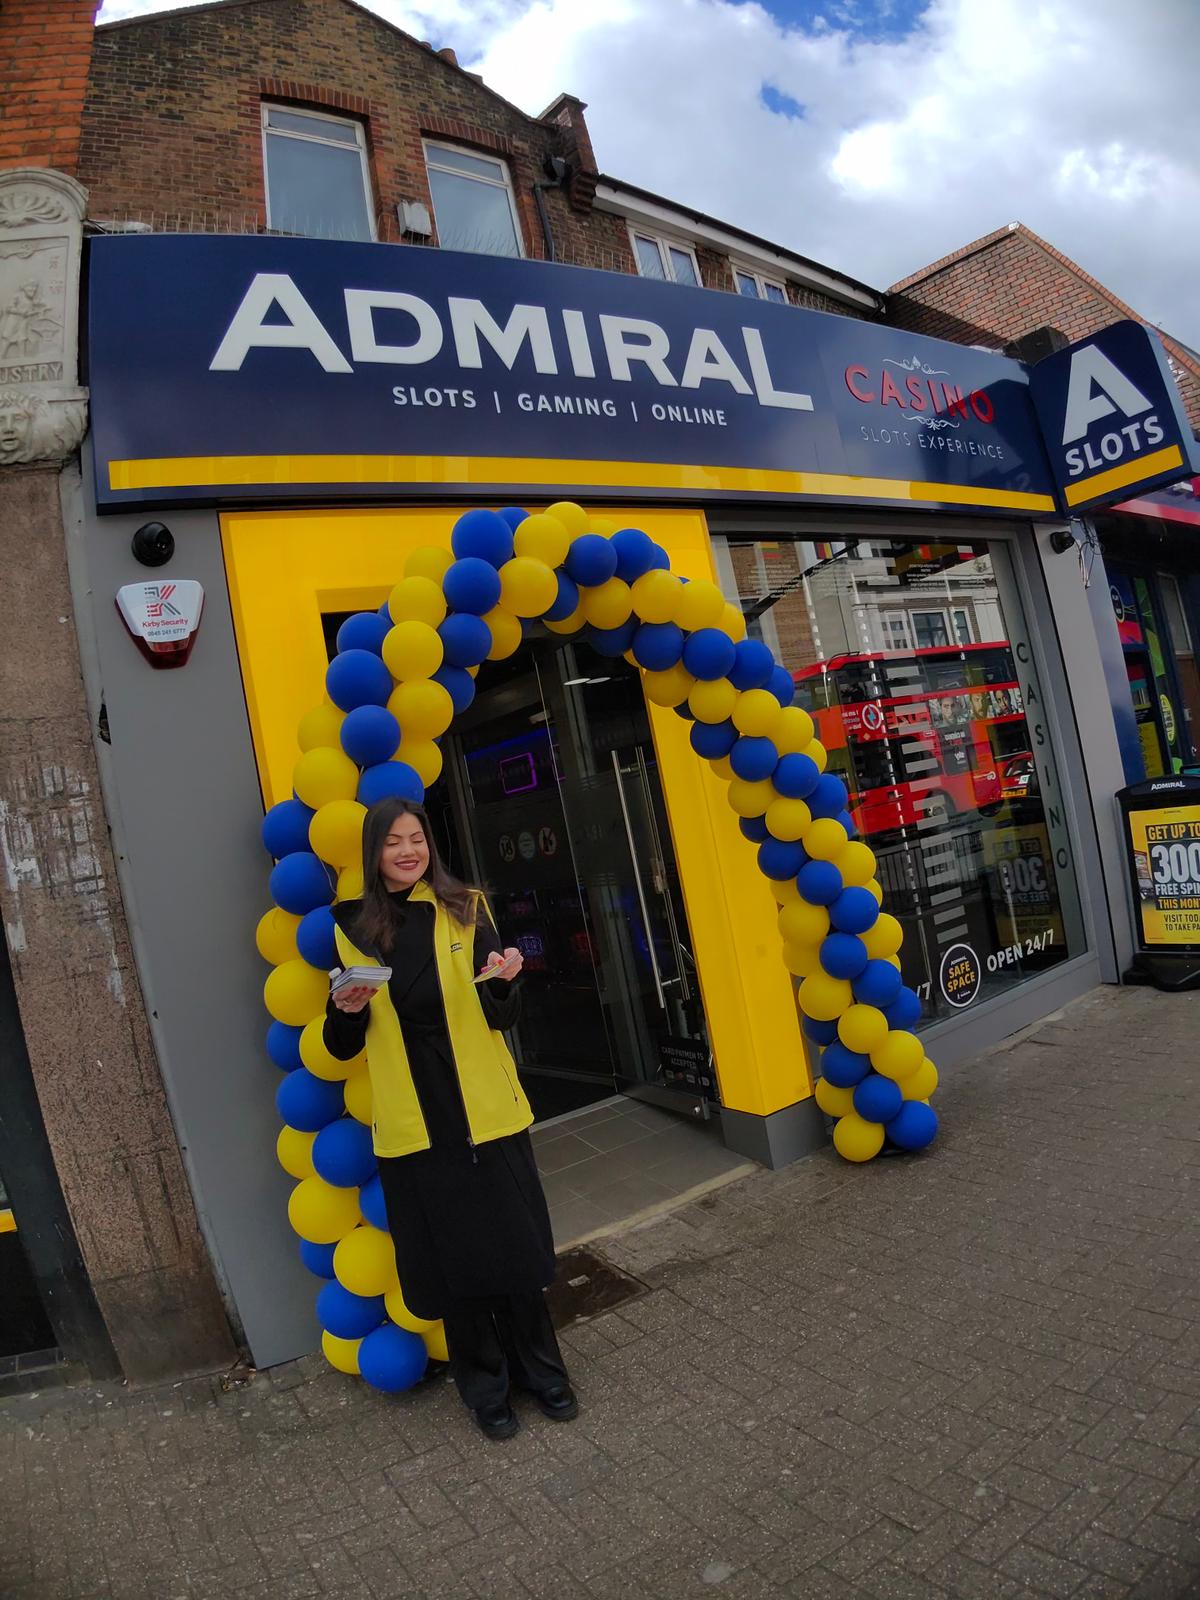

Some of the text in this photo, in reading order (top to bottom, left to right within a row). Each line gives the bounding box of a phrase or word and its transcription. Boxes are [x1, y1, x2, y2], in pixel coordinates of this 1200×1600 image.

[208, 272, 815, 412] ADMIRAL
[844, 363, 996, 424] CASINO
[1061, 343, 1154, 446] A
[392, 385, 477, 409] SLOTS
[517, 393, 618, 418] GAMING
[651, 403, 728, 427] ONLINE
[860, 425, 1005, 460] SLOTS EXPERIENCE
[1065, 415, 1165, 477] SLOTS
[160, 618, 188, 627] Security
[1150, 780, 1186, 791] ADMIRAL
[1148, 825, 1168, 841] GET
[1170, 824, 1186, 839] UP
[1151, 842, 1200, 884] 300
[1155, 883, 1179, 896] FREE
[1158, 898, 1200, 909] THIS MON
[1163, 913, 1200, 923] VISIT TOD
[1165, 923, 1174, 931] TO
[1174, 923, 1191, 931] TAKE
[986, 928, 1054, 972] OPEN 24/7
[948, 960, 971, 979] SAFE
[947, 971, 976, 993] SPACE
